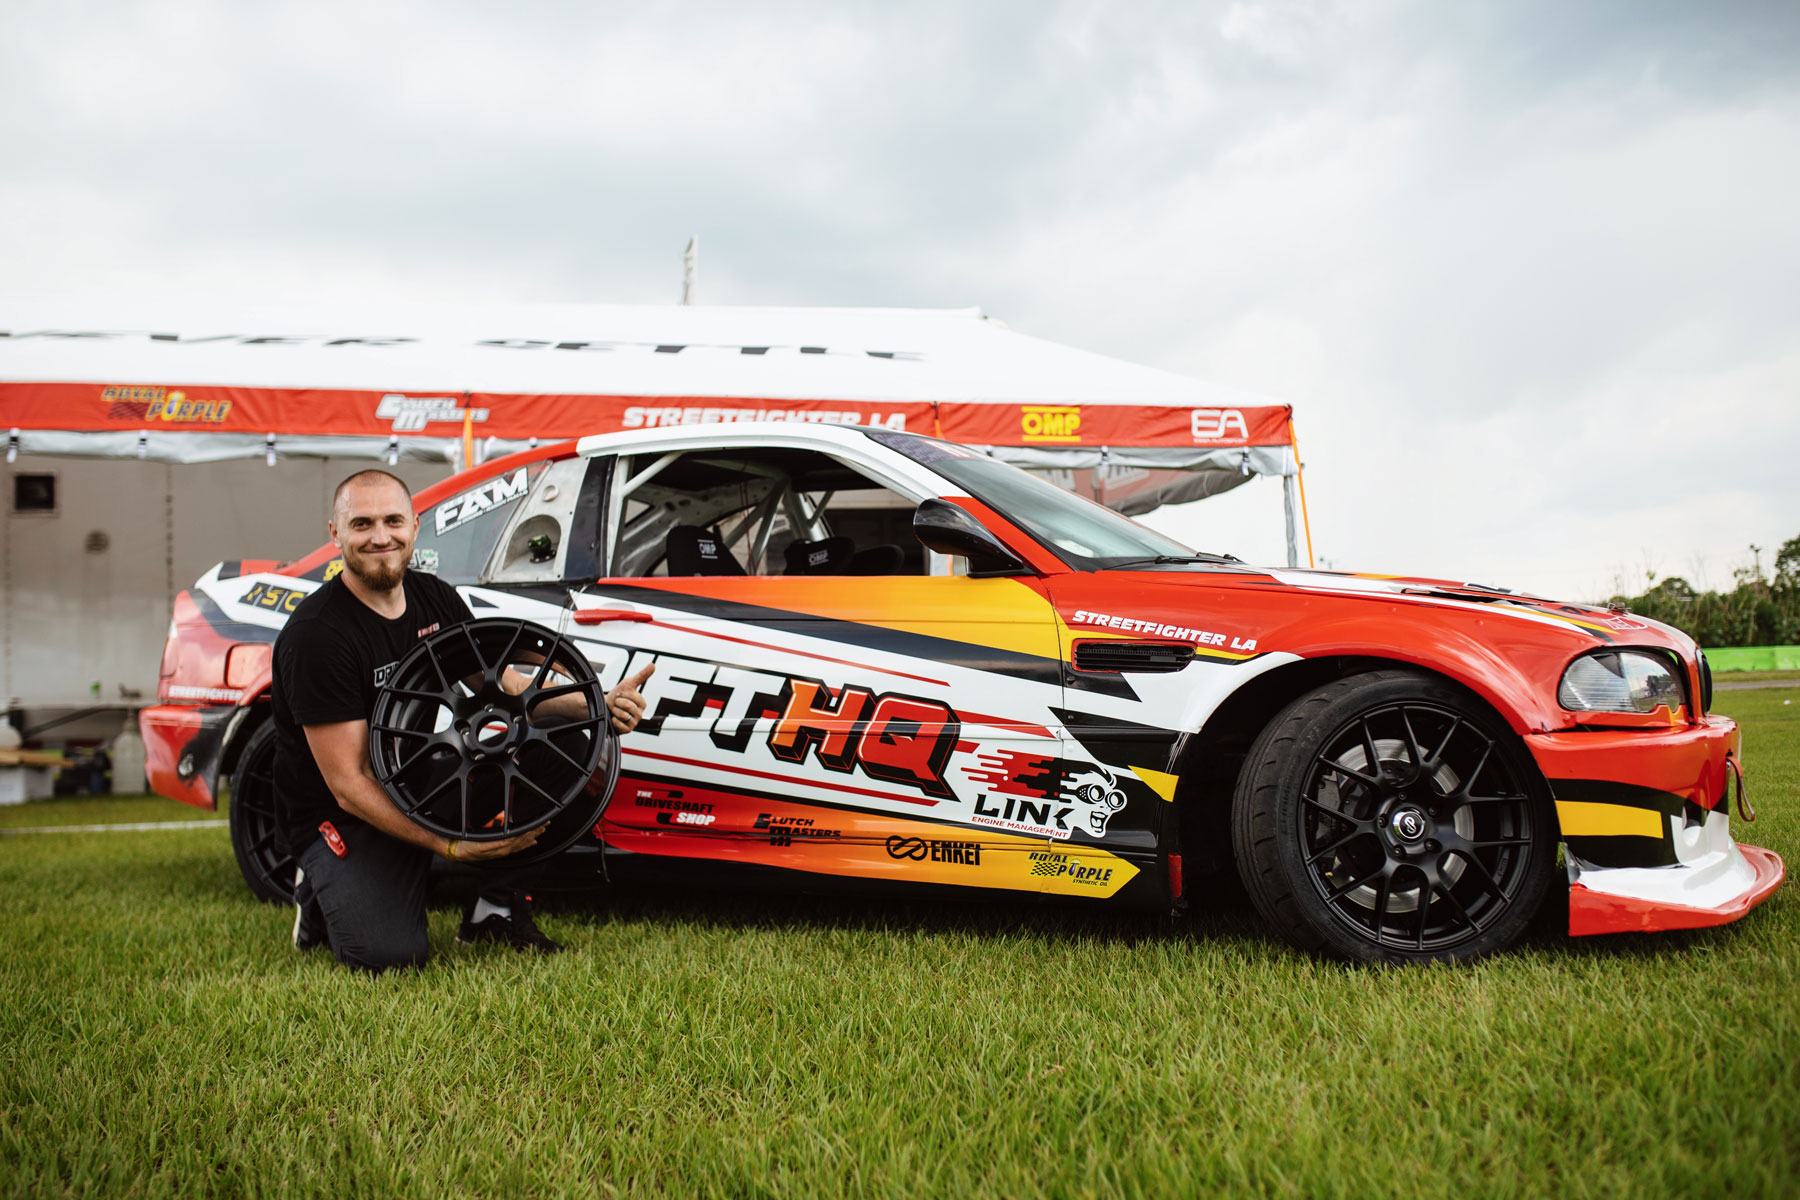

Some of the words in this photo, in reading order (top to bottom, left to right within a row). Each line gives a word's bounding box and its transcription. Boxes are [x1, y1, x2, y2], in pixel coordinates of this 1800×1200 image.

[869, 413, 906, 430] LA
[1021, 413, 1081, 436] OMP
[1191, 409, 1249, 439] EA
[435, 466, 528, 530] FAM
[699, 543, 717, 554] OMP
[809, 551, 829, 564] OMP
[1072, 610, 1226, 646] STREETFIGHTER
[1231, 637, 1257, 650] LA
[637, 790, 653, 798] THE
[635, 797, 715, 814] DRIVESHAFT
[974, 793, 1075, 830] LINK
[676, 812, 716, 826] SHOP
[753, 813, 815, 829] CLUTCH
[972, 816, 1004, 827] ENGINE
[769, 826, 841, 847] MASTERS
[930, 840, 981, 866] ENKEI
[1029, 852, 1068, 863] ROYAL
[1072, 879, 1098, 887] SYNTHETIC
